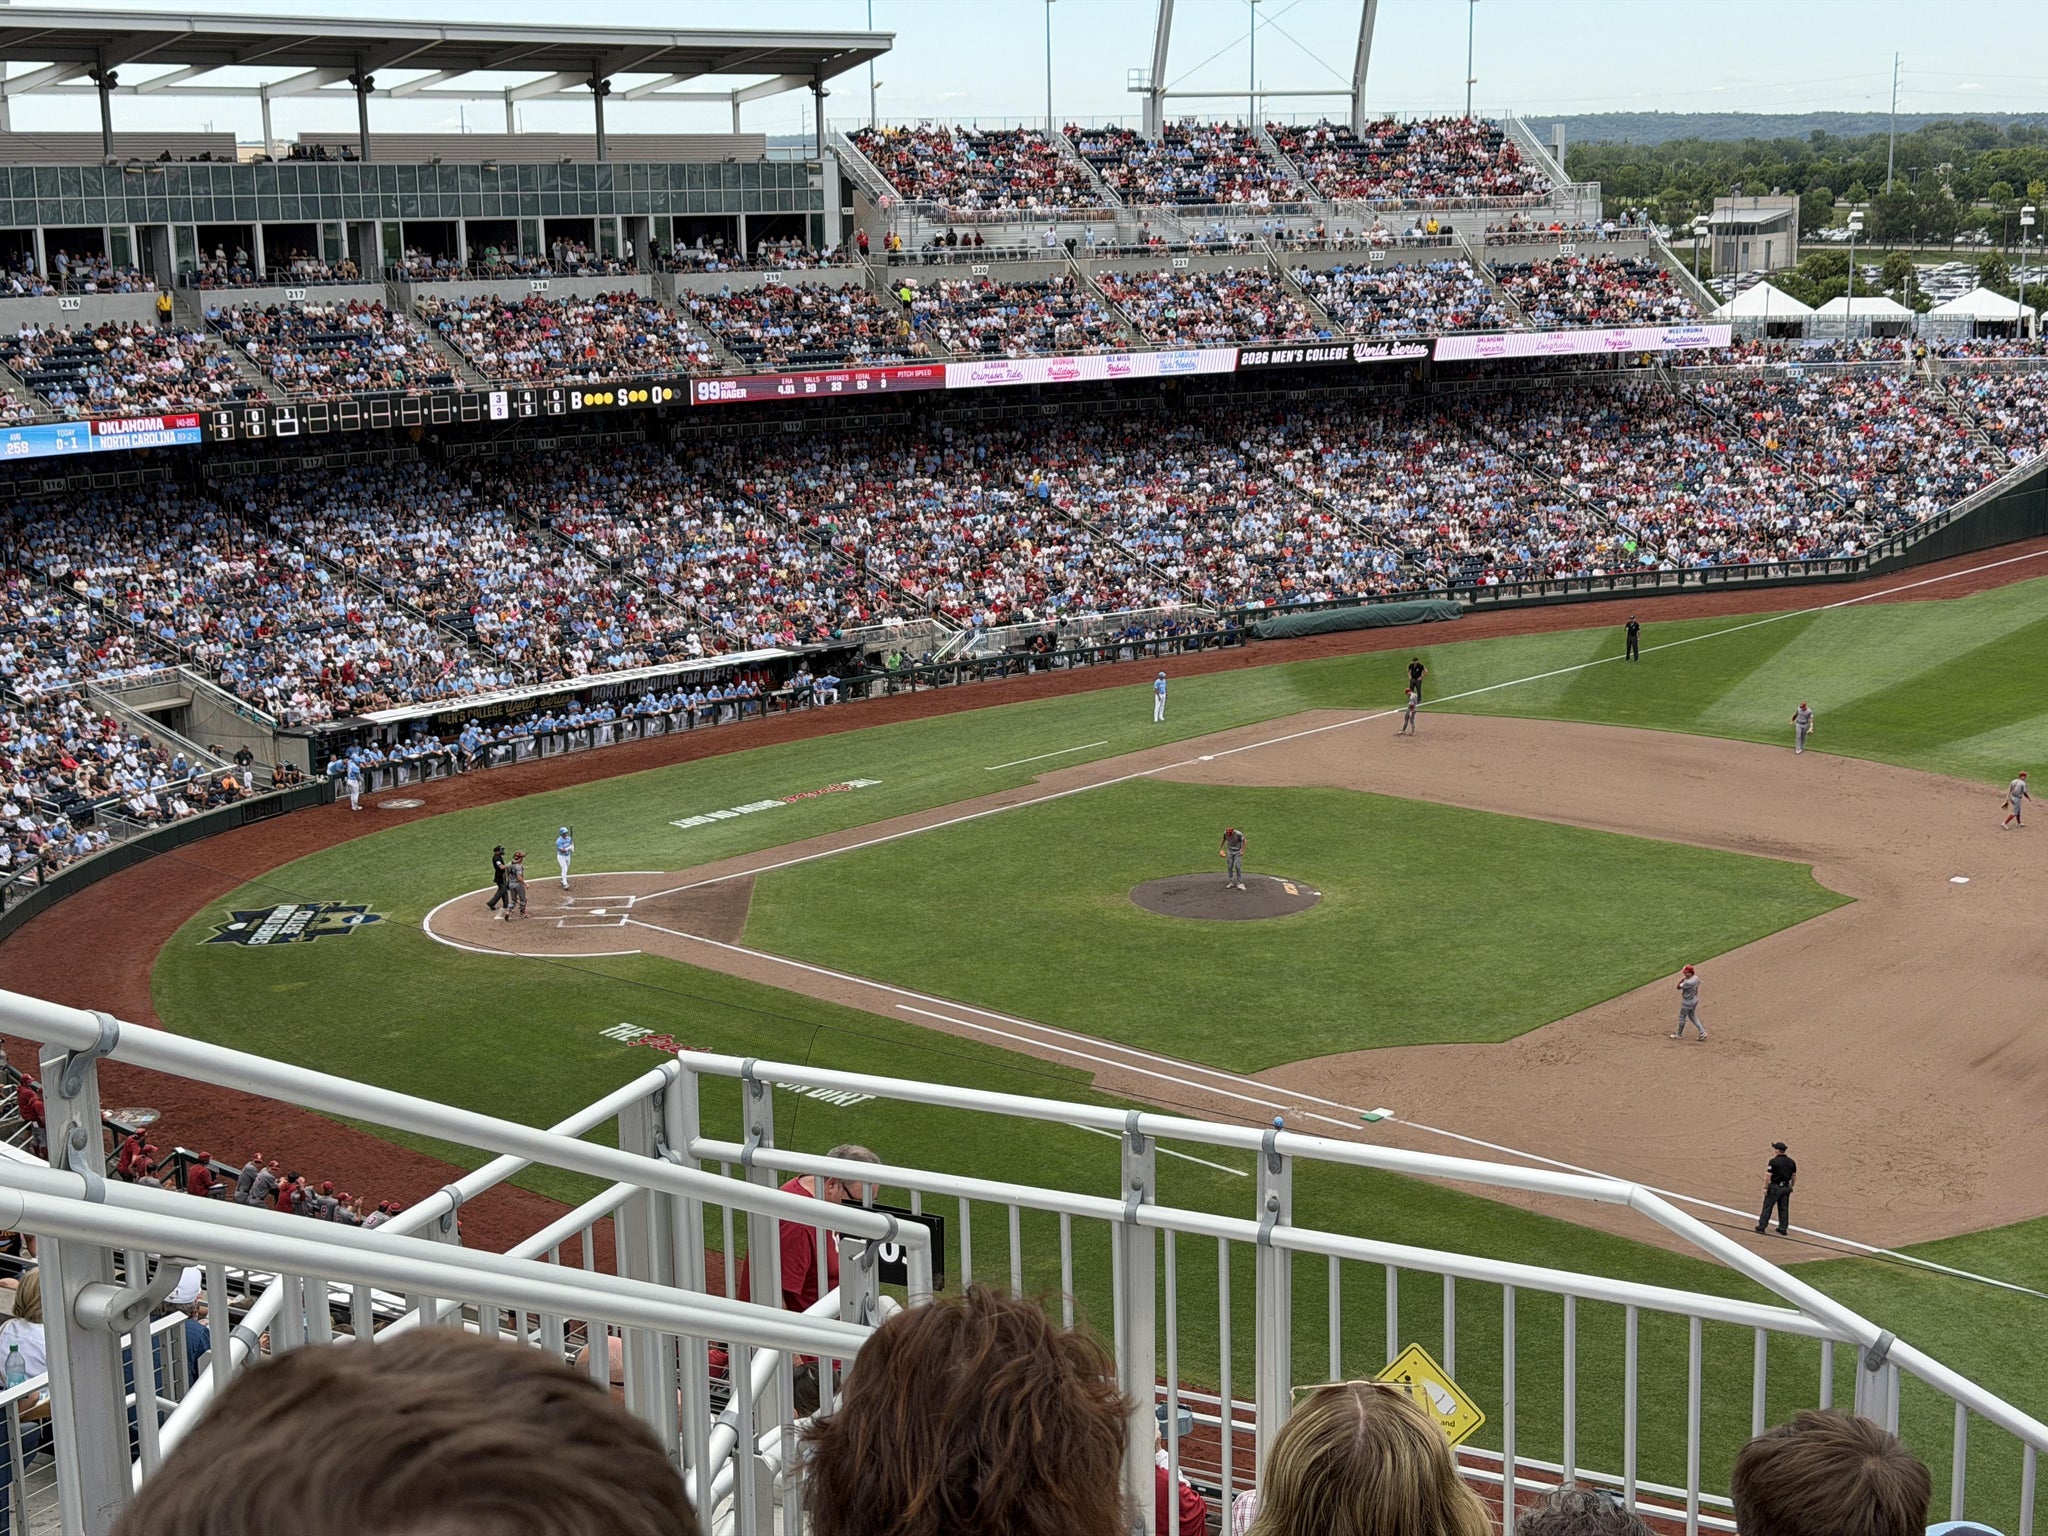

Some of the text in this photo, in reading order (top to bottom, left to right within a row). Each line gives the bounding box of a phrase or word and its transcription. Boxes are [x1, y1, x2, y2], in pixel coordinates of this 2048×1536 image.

[533, 282, 548, 290] 218
[288, 290, 304, 298] 217
[62, 300, 78, 308] 216
[1604, 338, 1632, 349] Trojans
[1241, 342, 1428, 365] 2026 MEN'S COLLEGE World Series
[914, 369, 932, 377] SPEED
[972, 370, 1023, 380] Crimson Tide
[1048, 367, 1080, 379] Bulldogs
[698, 381, 720, 400] 99
[720, 381, 736, 389] CORD
[806, 383, 816, 393] 20
[831, 382, 842, 392] 33
[857, 380, 868, 390] 53
[496, 394, 502, 404] 3
[524, 392, 530, 402] 4
[553, 390, 560, 400] 0
[618, 388, 628, 406] S
[720, 388, 747, 400] RAGER
[571, 391, 582, 410] B
[496, 407, 502, 416] 3
[526, 404, 532, 414] 5
[554, 402, 560, 413] 0
[220, 413, 228, 424] 2
[251, 410, 259, 422] 0
[284, 408, 290, 419] 1
[98, 417, 164, 435] OKLAHOMA
[252, 424, 260, 436] 0
[786, 422, 800, 430] 119
[57, 428, 76, 438] TODAY
[221, 426, 229, 438] 3
[101, 434, 130, 449] NORTH
[132, 430, 176, 446] CAROLINA
[4, 441, 29, 455] .258
[304, 458, 320, 467] 117
[46, 481, 62, 490] 116
[592, 683, 626, 700] NORTH
[629, 676, 678, 694] CAROLINA
[682, 670, 700, 684] TAR
[438, 710, 466, 724] MEN'S
[468, 706, 503, 720] COLLEGE
[506, 698, 536, 714] World
[540, 694, 575, 708] Series
[669, 816, 718, 828] DIRT
[278, 910, 314, 934] COLLEGE
[248, 924, 282, 944] SERIES
[598, 1022, 655, 1041] THE
[804, 1088, 876, 1106] DIRT
[1440, 1420, 1456, 1428] and
